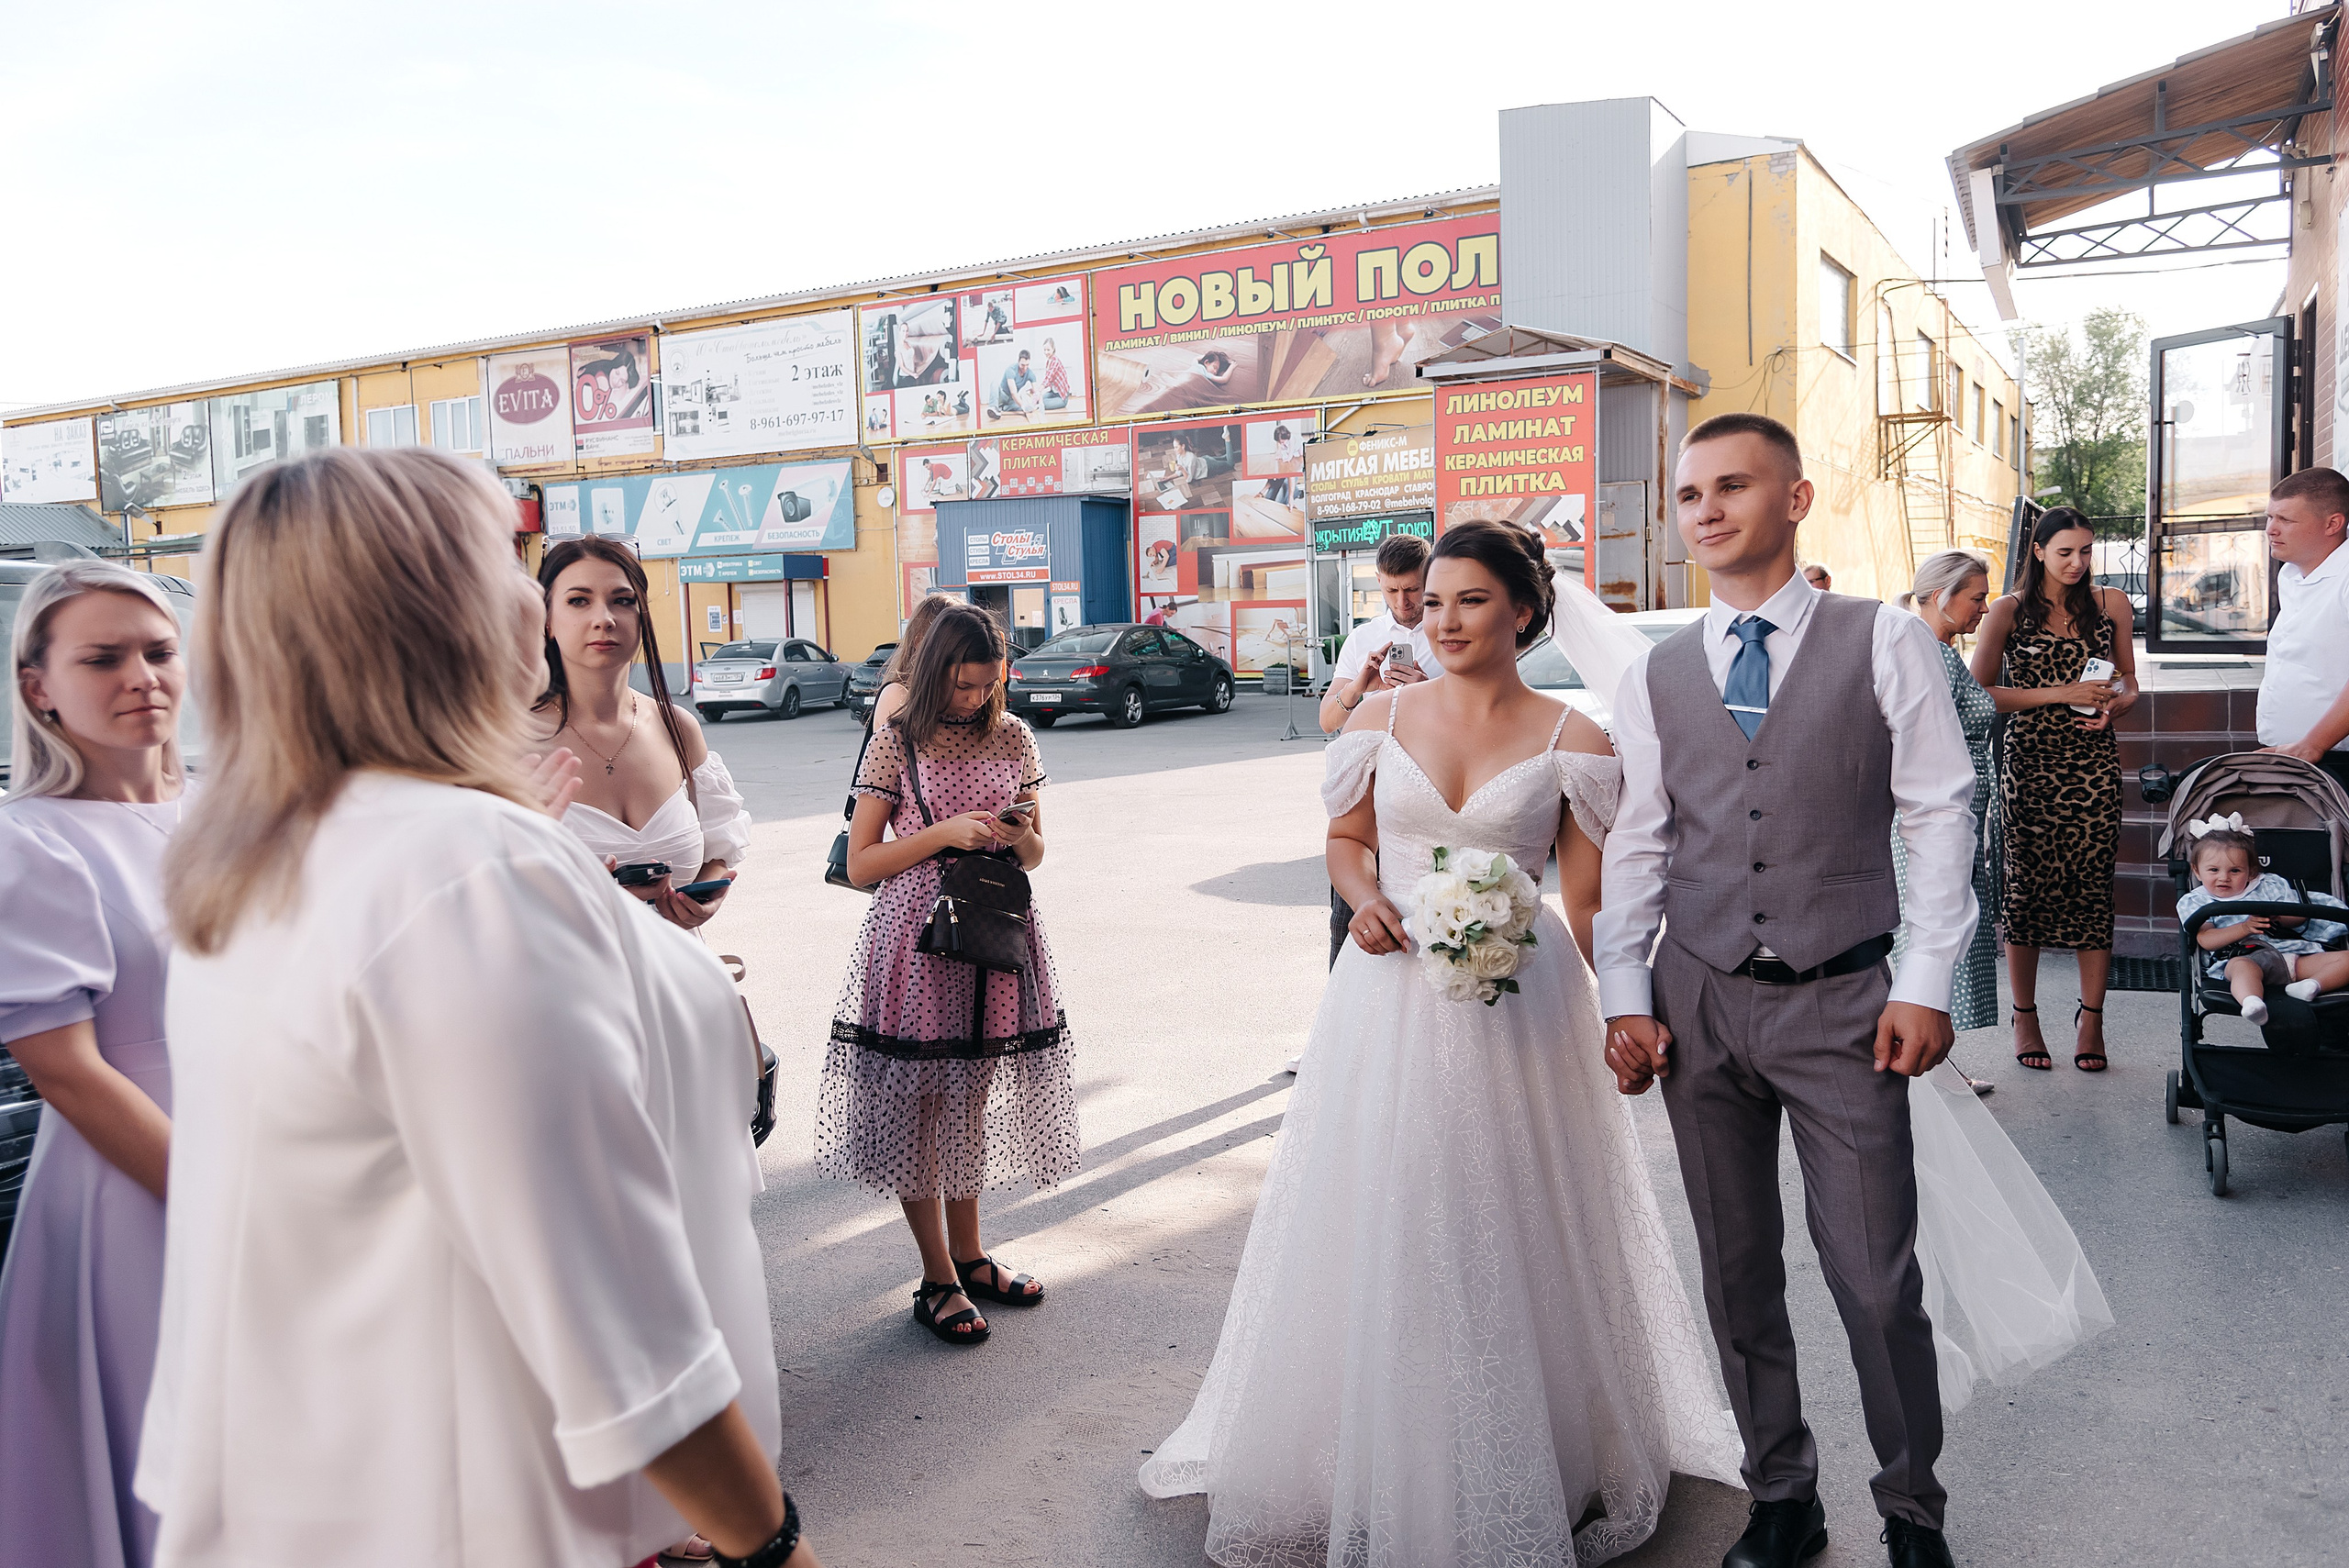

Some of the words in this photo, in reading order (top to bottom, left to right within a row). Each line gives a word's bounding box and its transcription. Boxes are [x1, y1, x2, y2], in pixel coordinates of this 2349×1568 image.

[1119, 244, 1333, 333] НОВЫЙ
[1357, 232, 1500, 303] ПОЛ
[1105, 334, 1161, 351] ЛАМИНАТ
[1170, 328, 1209, 345] ВИНИЛ
[1219, 319, 1286, 338] ЛИНОЛЕУМ
[1297, 310, 1356, 328] ПЛИНТУС
[1365, 303, 1419, 321] ПОРОГИ
[1431, 294, 1487, 313] ПЛИТКА
[744, 352, 772, 363] Больше
[788, 344, 814, 357] просто
[816, 335, 841, 348] мебель
[791, 365, 799, 382] 2
[804, 363, 843, 380] этаж
[300, 391, 333, 406] ЛЕРОМ
[498, 388, 555, 414] EVITA
[1445, 384, 1584, 415] ЛИНОЛЕУМ
[751, 409, 844, 430] 8-961-697-97-17
[54, 427, 63, 441] НА
[66, 424, 86, 440] ЗАКАЗ
[1453, 416, 1576, 445] ЛАМИНАТ
[1002, 430, 1108, 451] КЕРАМИЧЕСКАЯ
[1359, 436, 1408, 452] ФЕНИКС-М
[1003, 454, 1057, 471] ПЛИТКА
[1310, 454, 1378, 482] МЯГКАЯ
[1444, 445, 1585, 472] КЕРАМИЧЕСКАЯ
[1311, 482, 1336, 493] СТОЛЫ
[1341, 477, 1369, 489] СТУЛЬЯ
[1373, 473, 1409, 484] КРОВАТИ
[1460, 471, 1567, 496] ПЛИТКА
[1311, 491, 1352, 504] ВОЛГОГРАД
[1355, 485, 1399, 498] КРАСНОДАР
[1404, 482, 1434, 493] СТАВРО
[550, 501, 566, 511] ЭТМ
[1317, 500, 1381, 515] 8-906-168-79-02
[657, 538, 672, 546] СВЕТ
[714, 534, 740, 543] КРЕПЕЖ
[767, 529, 820, 540] БЕЗОПАСНОСТЬ
[681, 564, 702, 576] ЭТМ
[980, 571, 1036, 580] www.STOL34.RU
[1052, 583, 1078, 591] STOL34.RU
